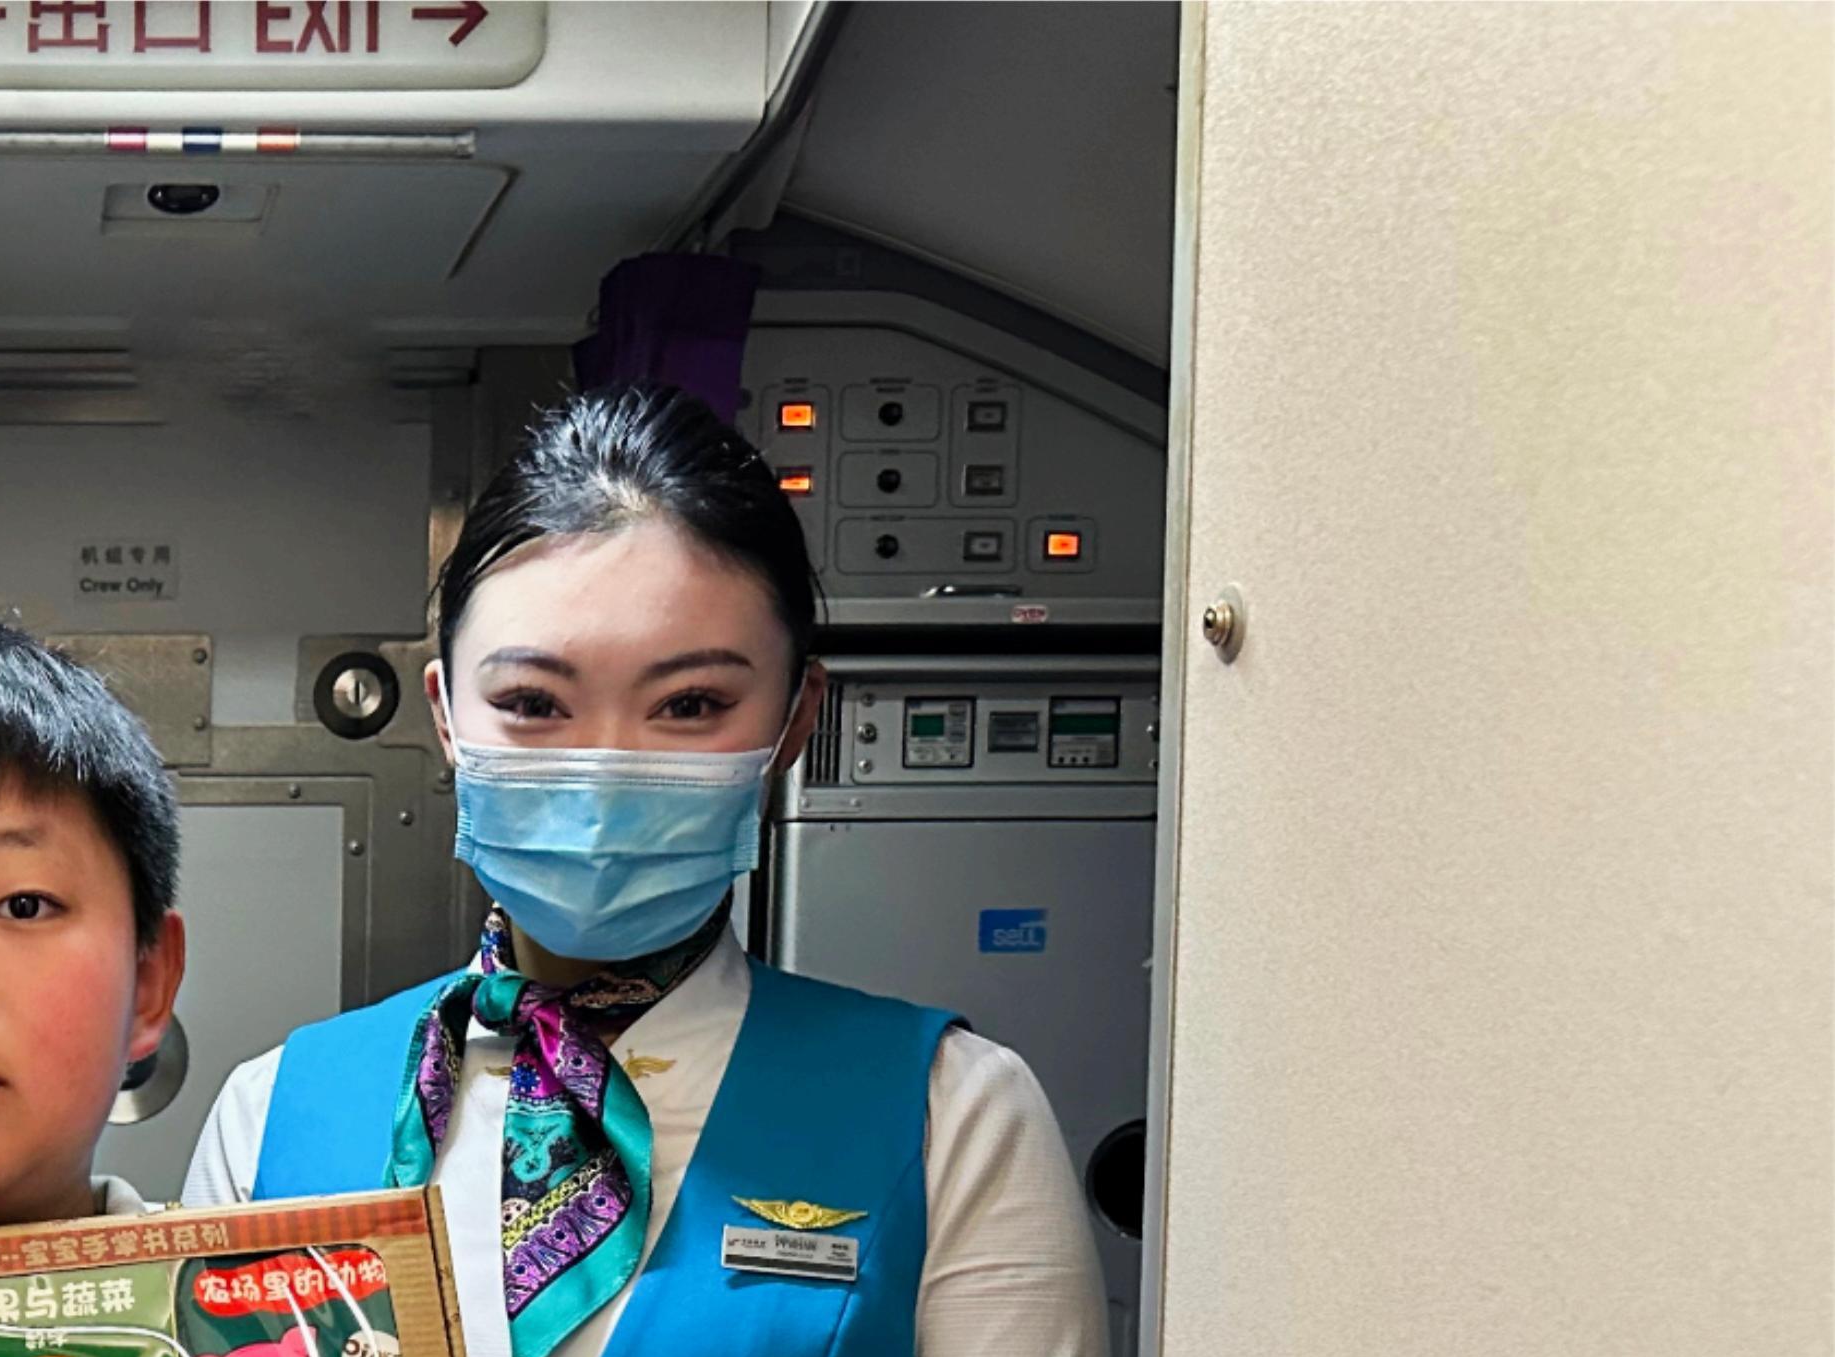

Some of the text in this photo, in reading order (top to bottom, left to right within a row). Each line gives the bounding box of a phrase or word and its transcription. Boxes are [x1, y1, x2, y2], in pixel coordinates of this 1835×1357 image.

[27, 0, 211, 53] 出口
[80, 576, 163, 600] Crew Only
